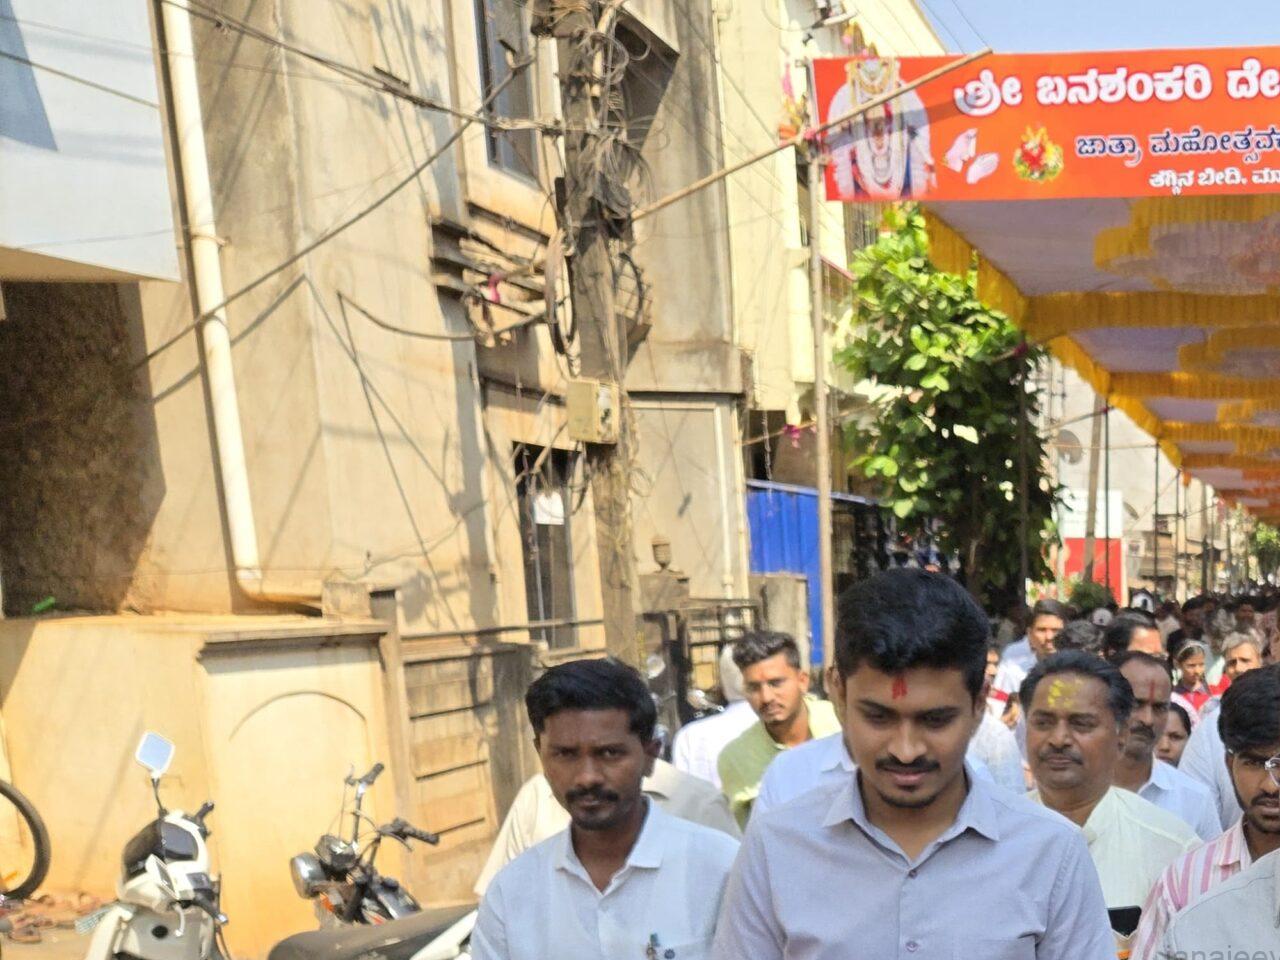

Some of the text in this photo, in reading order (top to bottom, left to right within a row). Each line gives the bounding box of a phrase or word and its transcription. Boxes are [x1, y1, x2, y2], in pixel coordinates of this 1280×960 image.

[954, 69, 1022, 116] ಶ್ರೀ
[1036, 63, 1212, 105] ಬನಶಂಕರಿ
[1076, 134, 1142, 165] ಜಾತ್ರಾ
